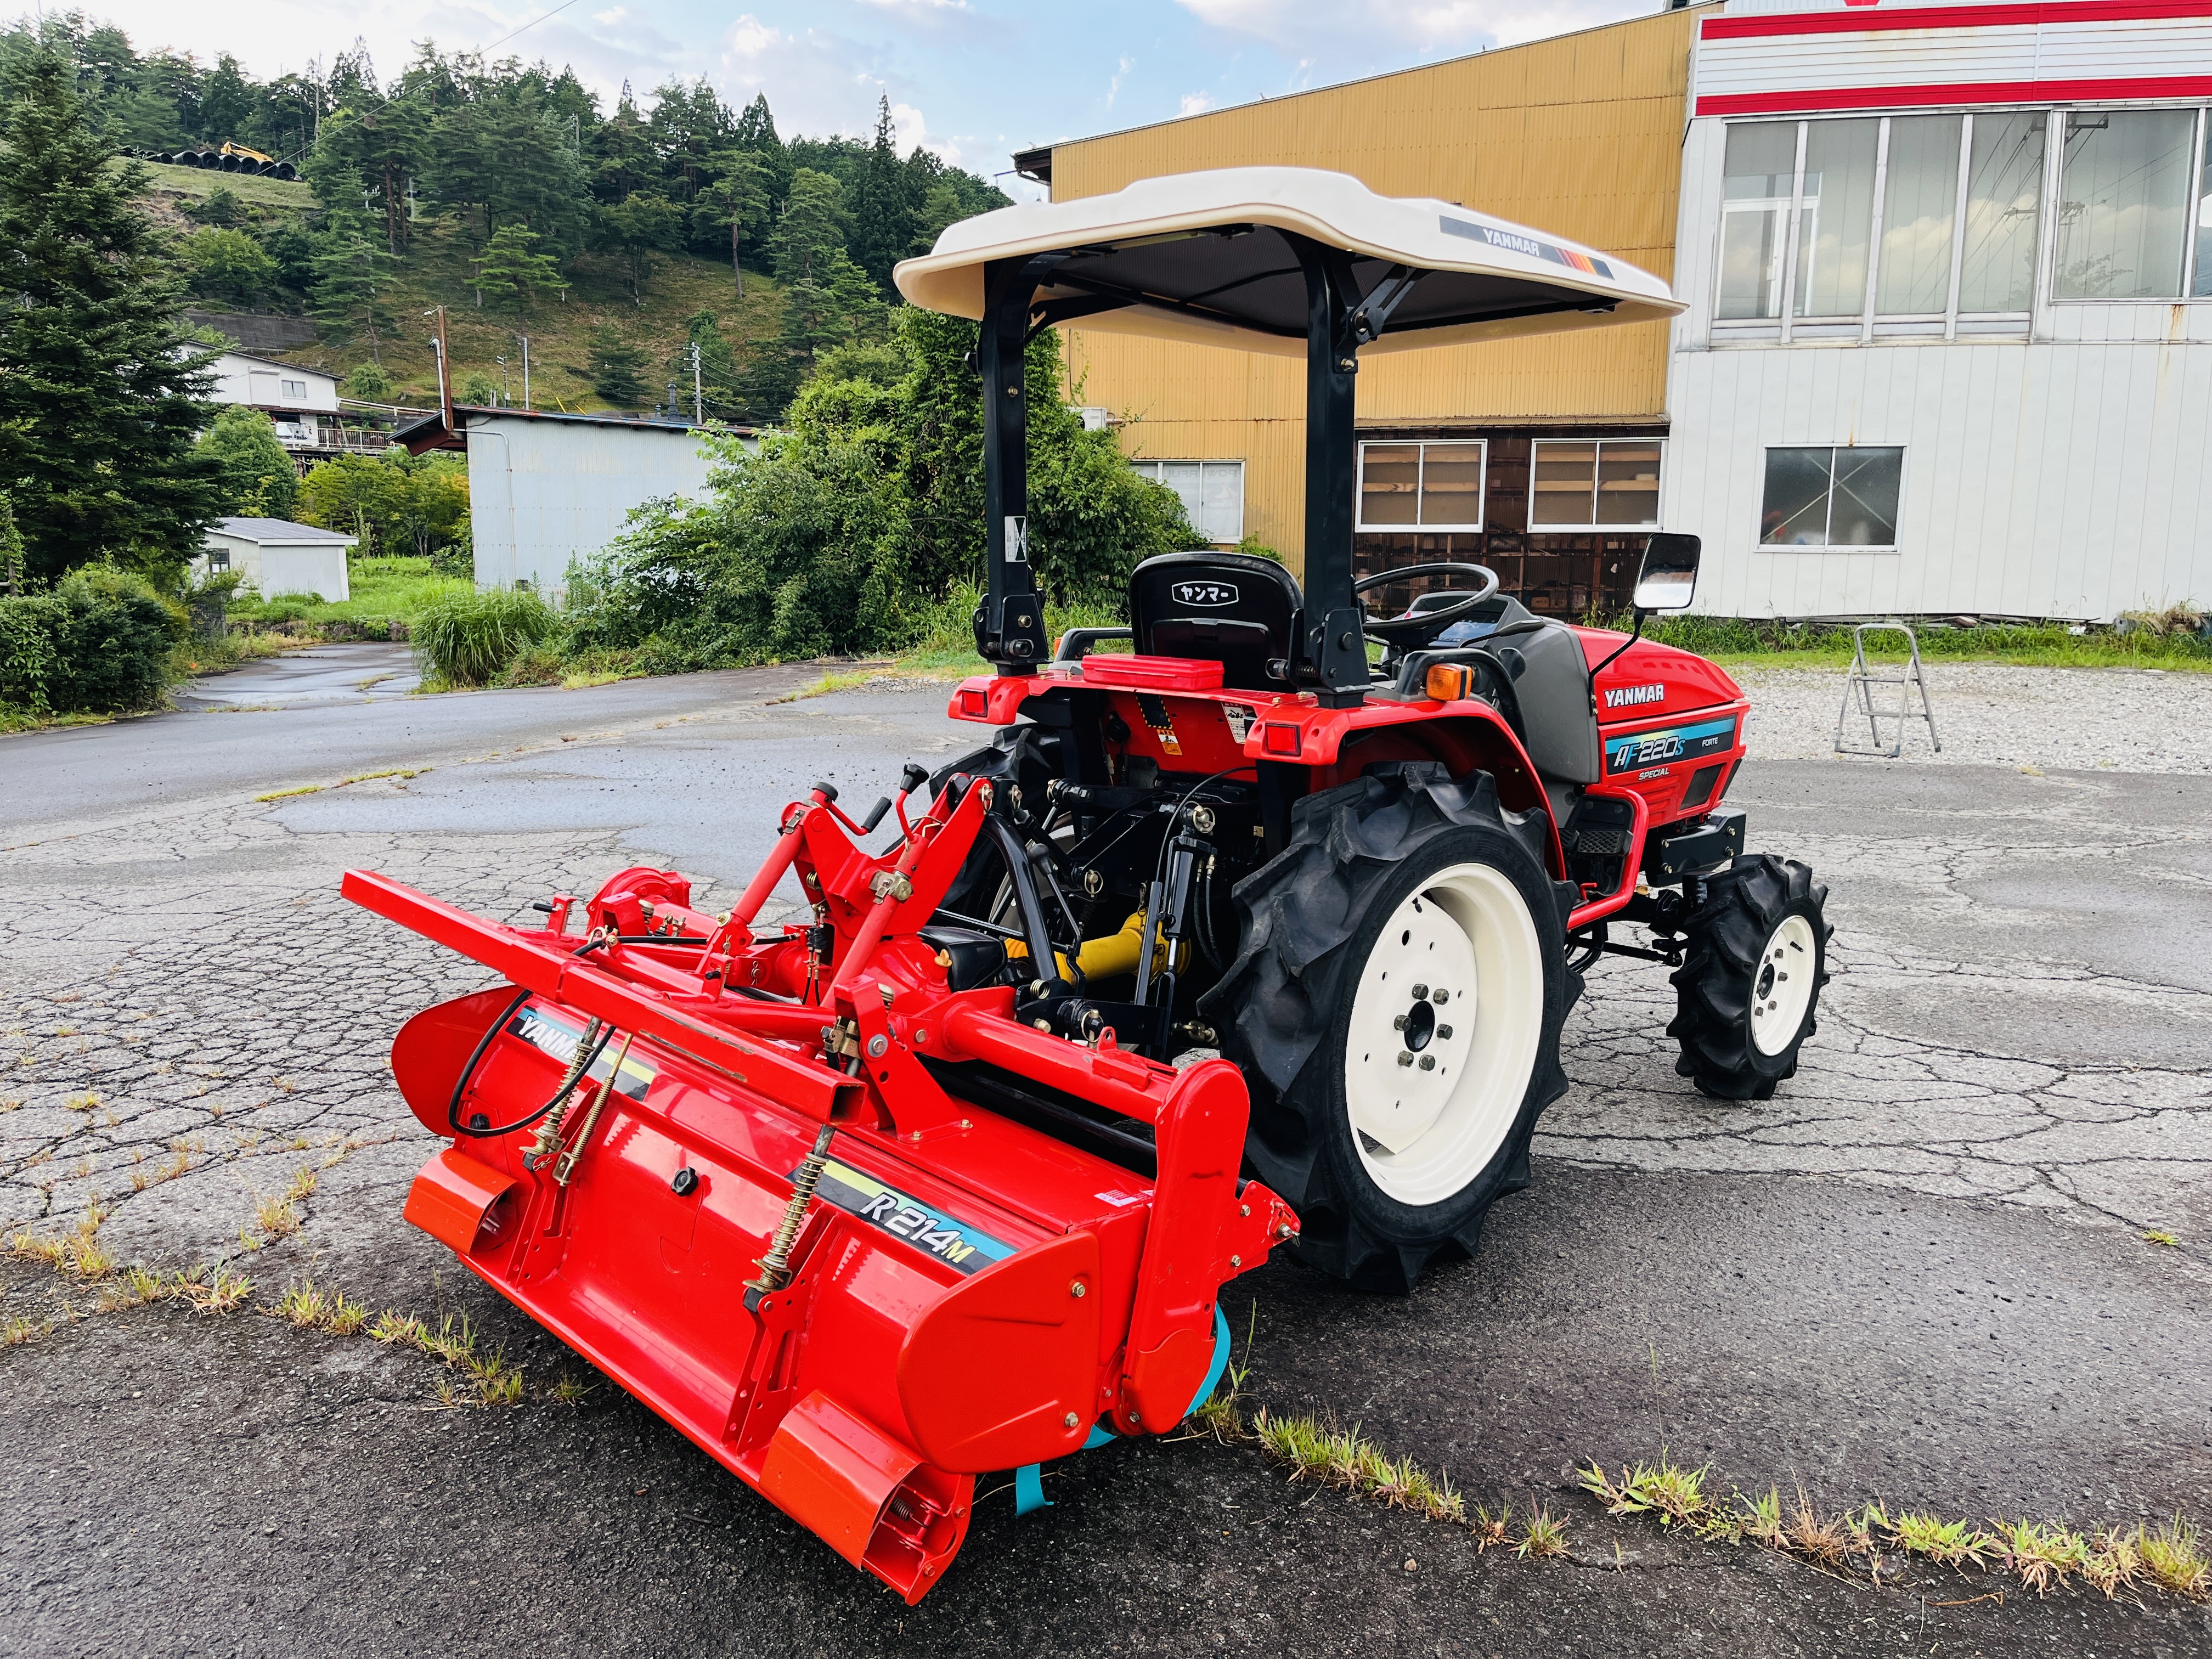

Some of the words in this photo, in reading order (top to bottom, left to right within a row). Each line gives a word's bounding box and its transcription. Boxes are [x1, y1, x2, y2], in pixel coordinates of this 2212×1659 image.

[1482, 228, 1539, 256] YANMAR
[1181, 585, 1228, 601] ヤンマー
[1604, 684, 1664, 708] YANMAR
[1702, 737, 1718, 747] FORTE
[1638, 767, 1669, 781] SPECIAL
